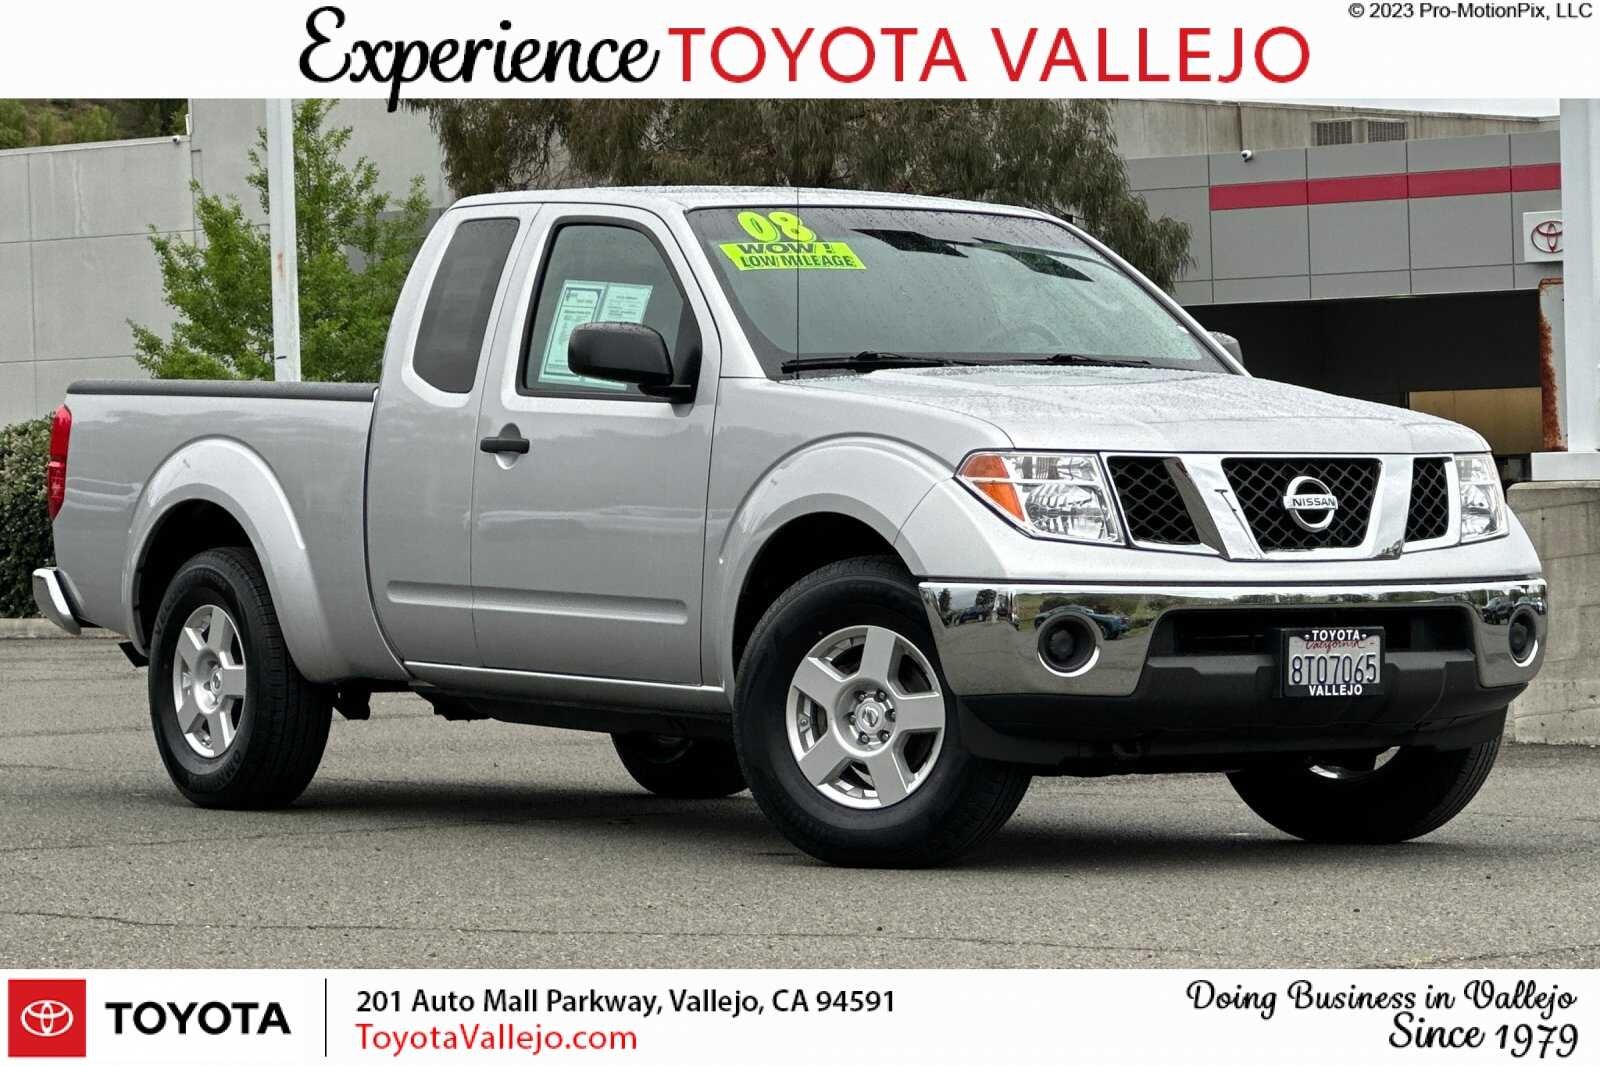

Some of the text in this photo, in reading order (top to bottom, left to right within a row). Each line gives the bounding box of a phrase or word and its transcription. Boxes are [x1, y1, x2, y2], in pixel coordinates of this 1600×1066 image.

[738, 211, 816, 242] 08
[740, 255, 855, 267] LOW MILEAGE
[1292, 497, 1336, 507] NISSAN
[1311, 629, 1361, 641] TOYOTA
[1291, 655, 1377, 684] 8T07065
[1308, 684, 1363, 696] VALLEJO
